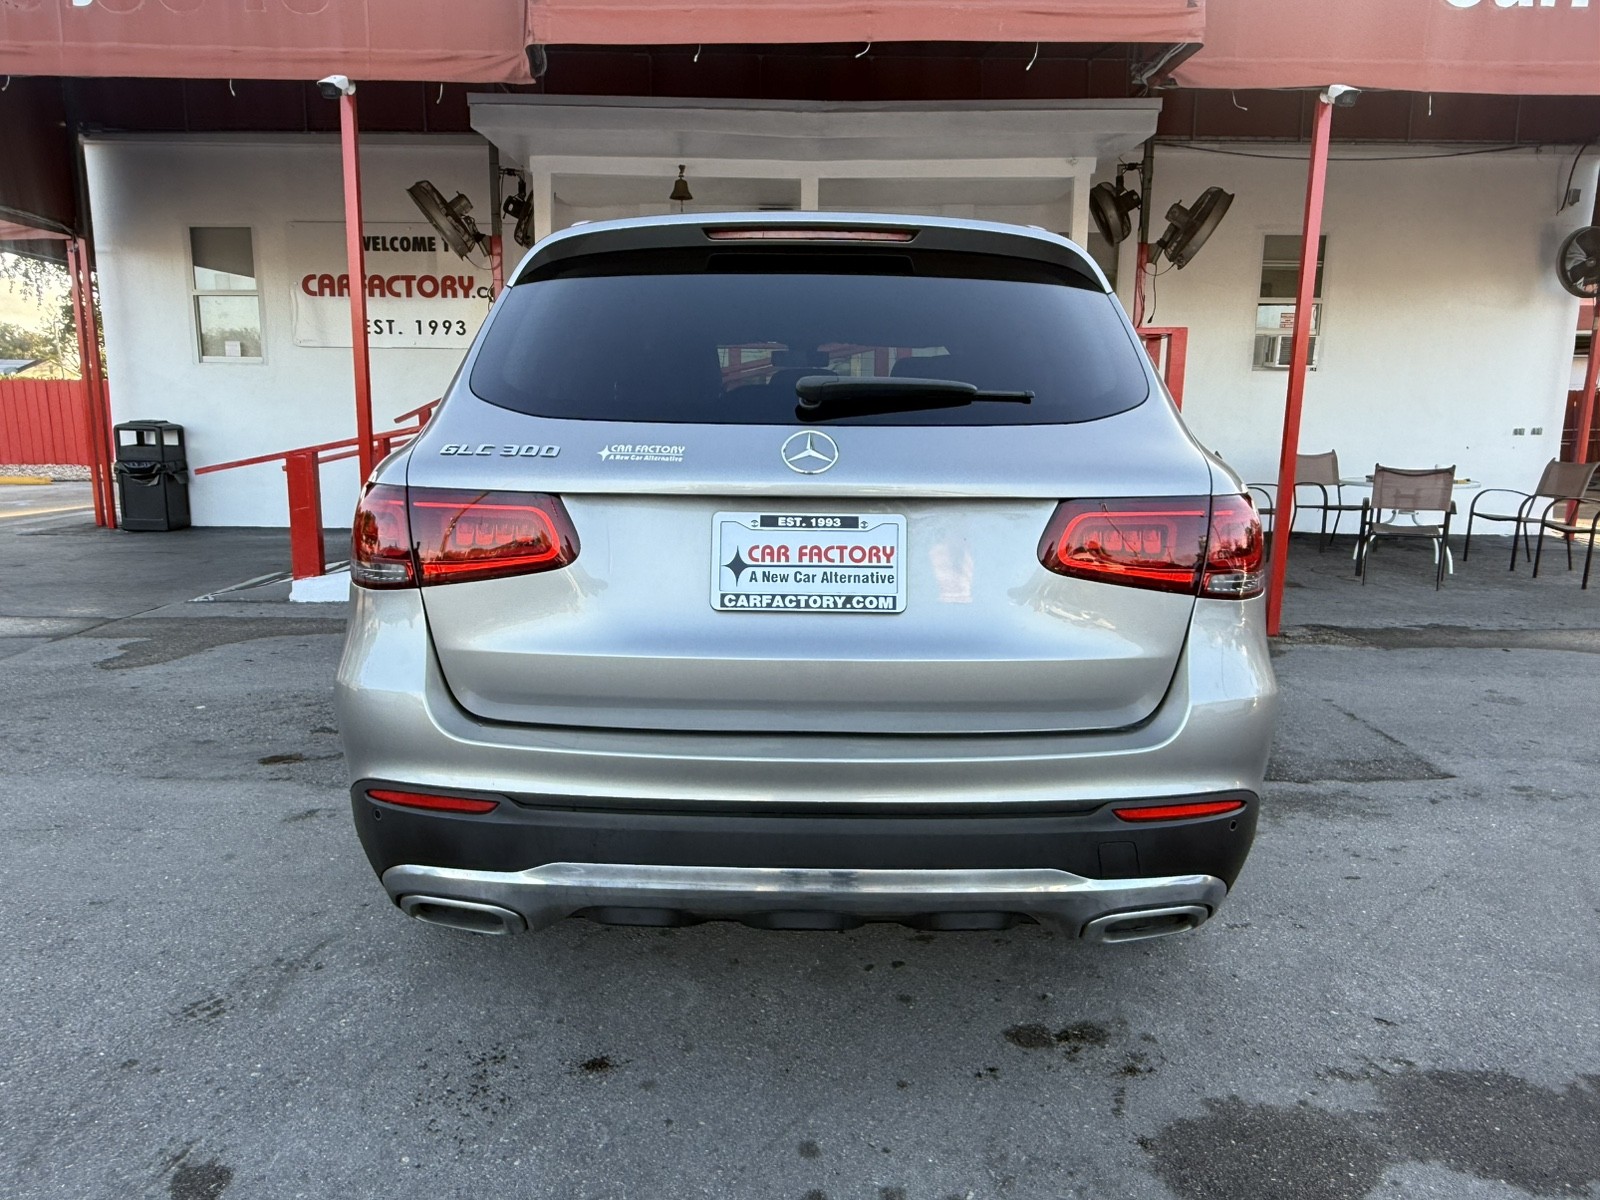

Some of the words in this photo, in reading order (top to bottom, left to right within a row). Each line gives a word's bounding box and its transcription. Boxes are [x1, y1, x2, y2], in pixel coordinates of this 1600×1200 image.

[415, 320, 467, 336] 1993
[440, 444, 496, 456] GLC
[500, 444, 561, 458] 300
[611, 444, 633, 453] CAR
[635, 445, 686, 454] FACTORY
[777, 516, 806, 527] EST.
[810, 517, 842, 527] 1993
[748, 544, 790, 563] CAR
[798, 545, 895, 564] FACTORY
[749, 570, 758, 583] A
[762, 571, 790, 583] New
[794, 571, 817, 583] Car
[821, 571, 895, 584] Alternative
[723, 594, 894, 609] CARFACTORY.COM
